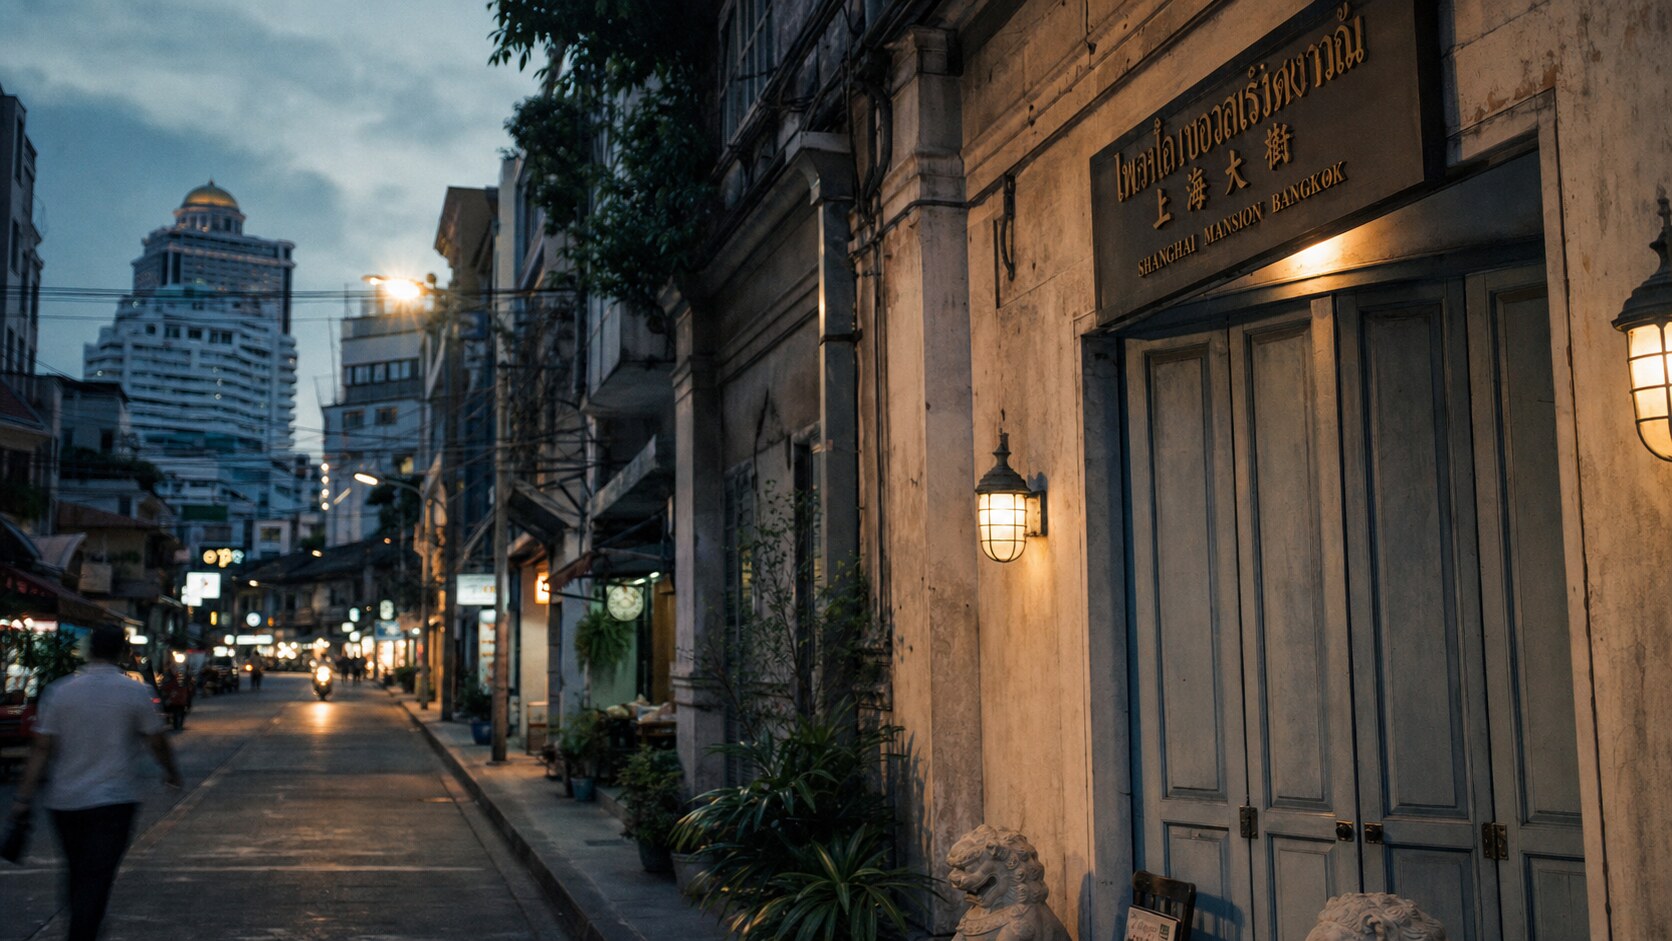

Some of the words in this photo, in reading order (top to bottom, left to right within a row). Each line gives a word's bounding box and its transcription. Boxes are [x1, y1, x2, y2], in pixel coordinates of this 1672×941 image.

[1137, 234, 1197, 278] SHANGHAI
[1203, 202, 1264, 246] MANSION
[1271, 160, 1347, 214] BANGKOK
